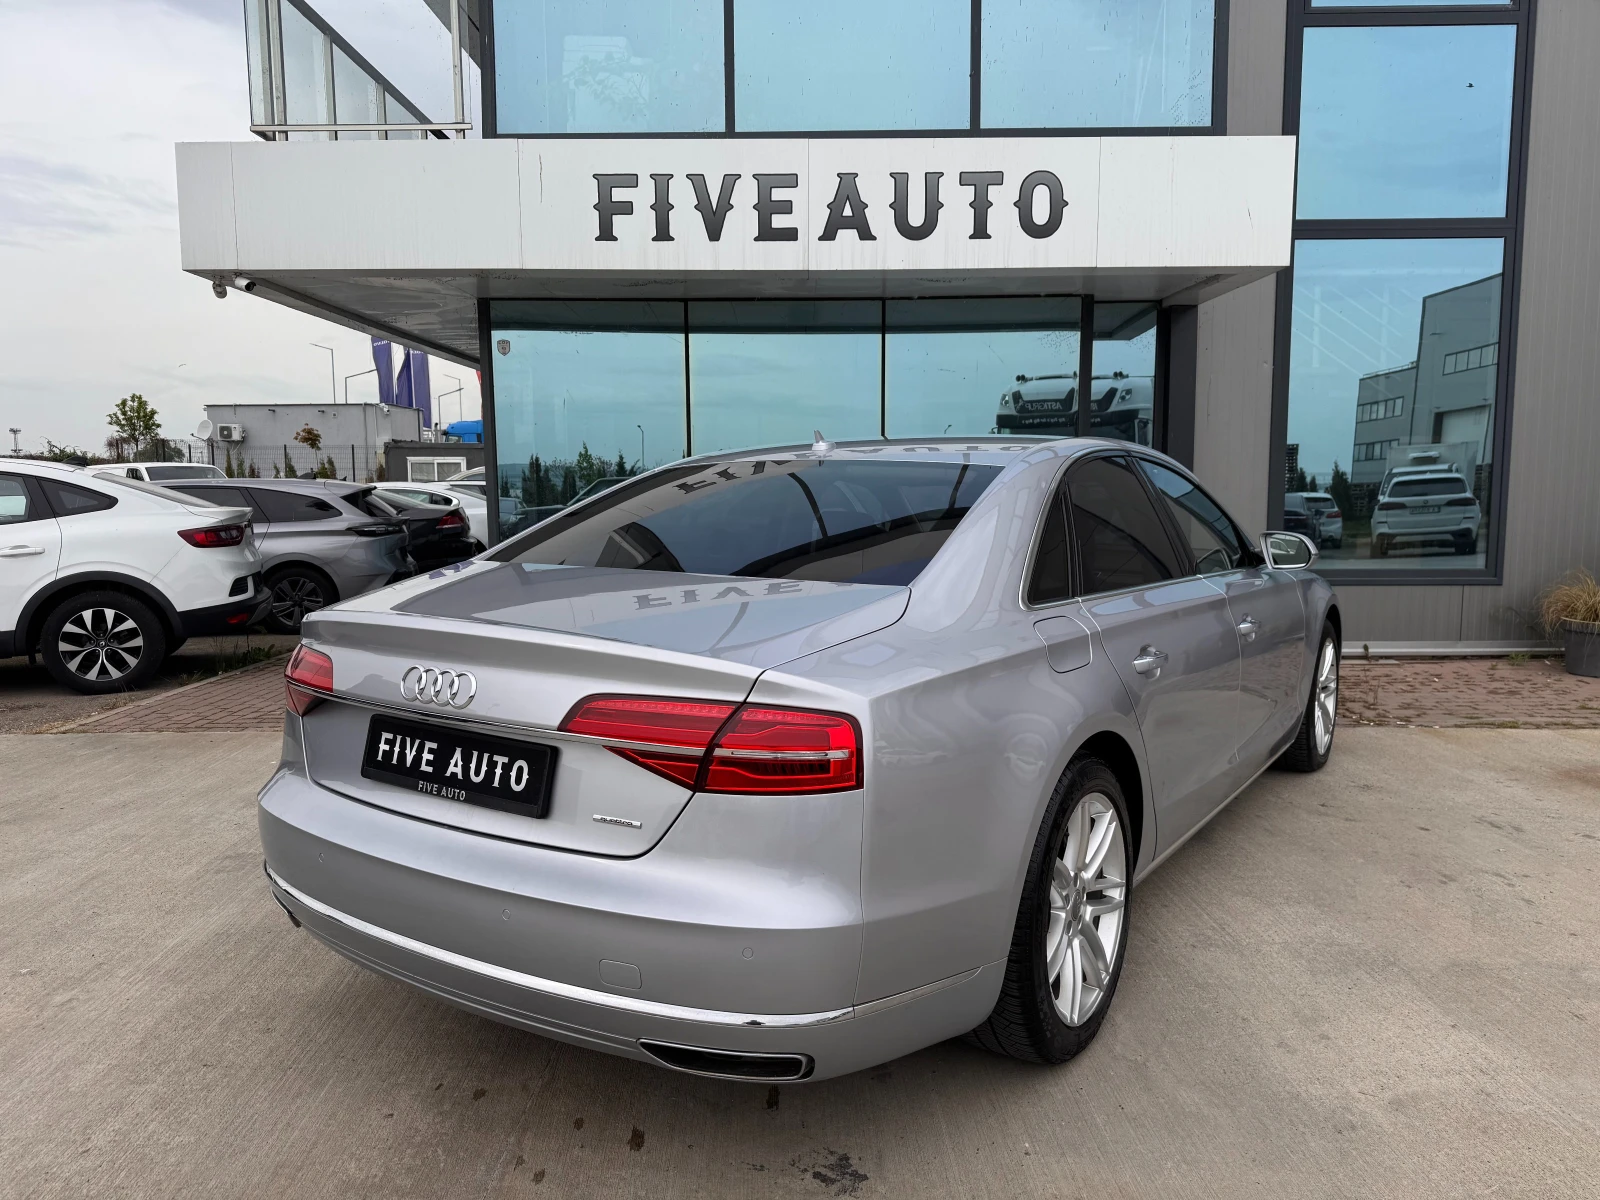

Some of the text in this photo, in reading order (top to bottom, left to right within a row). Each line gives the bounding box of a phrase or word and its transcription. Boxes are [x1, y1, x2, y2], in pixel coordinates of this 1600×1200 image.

[376, 731, 529, 792] FIVE AUTO
[417, 780, 466, 801] FIVE AUTO
